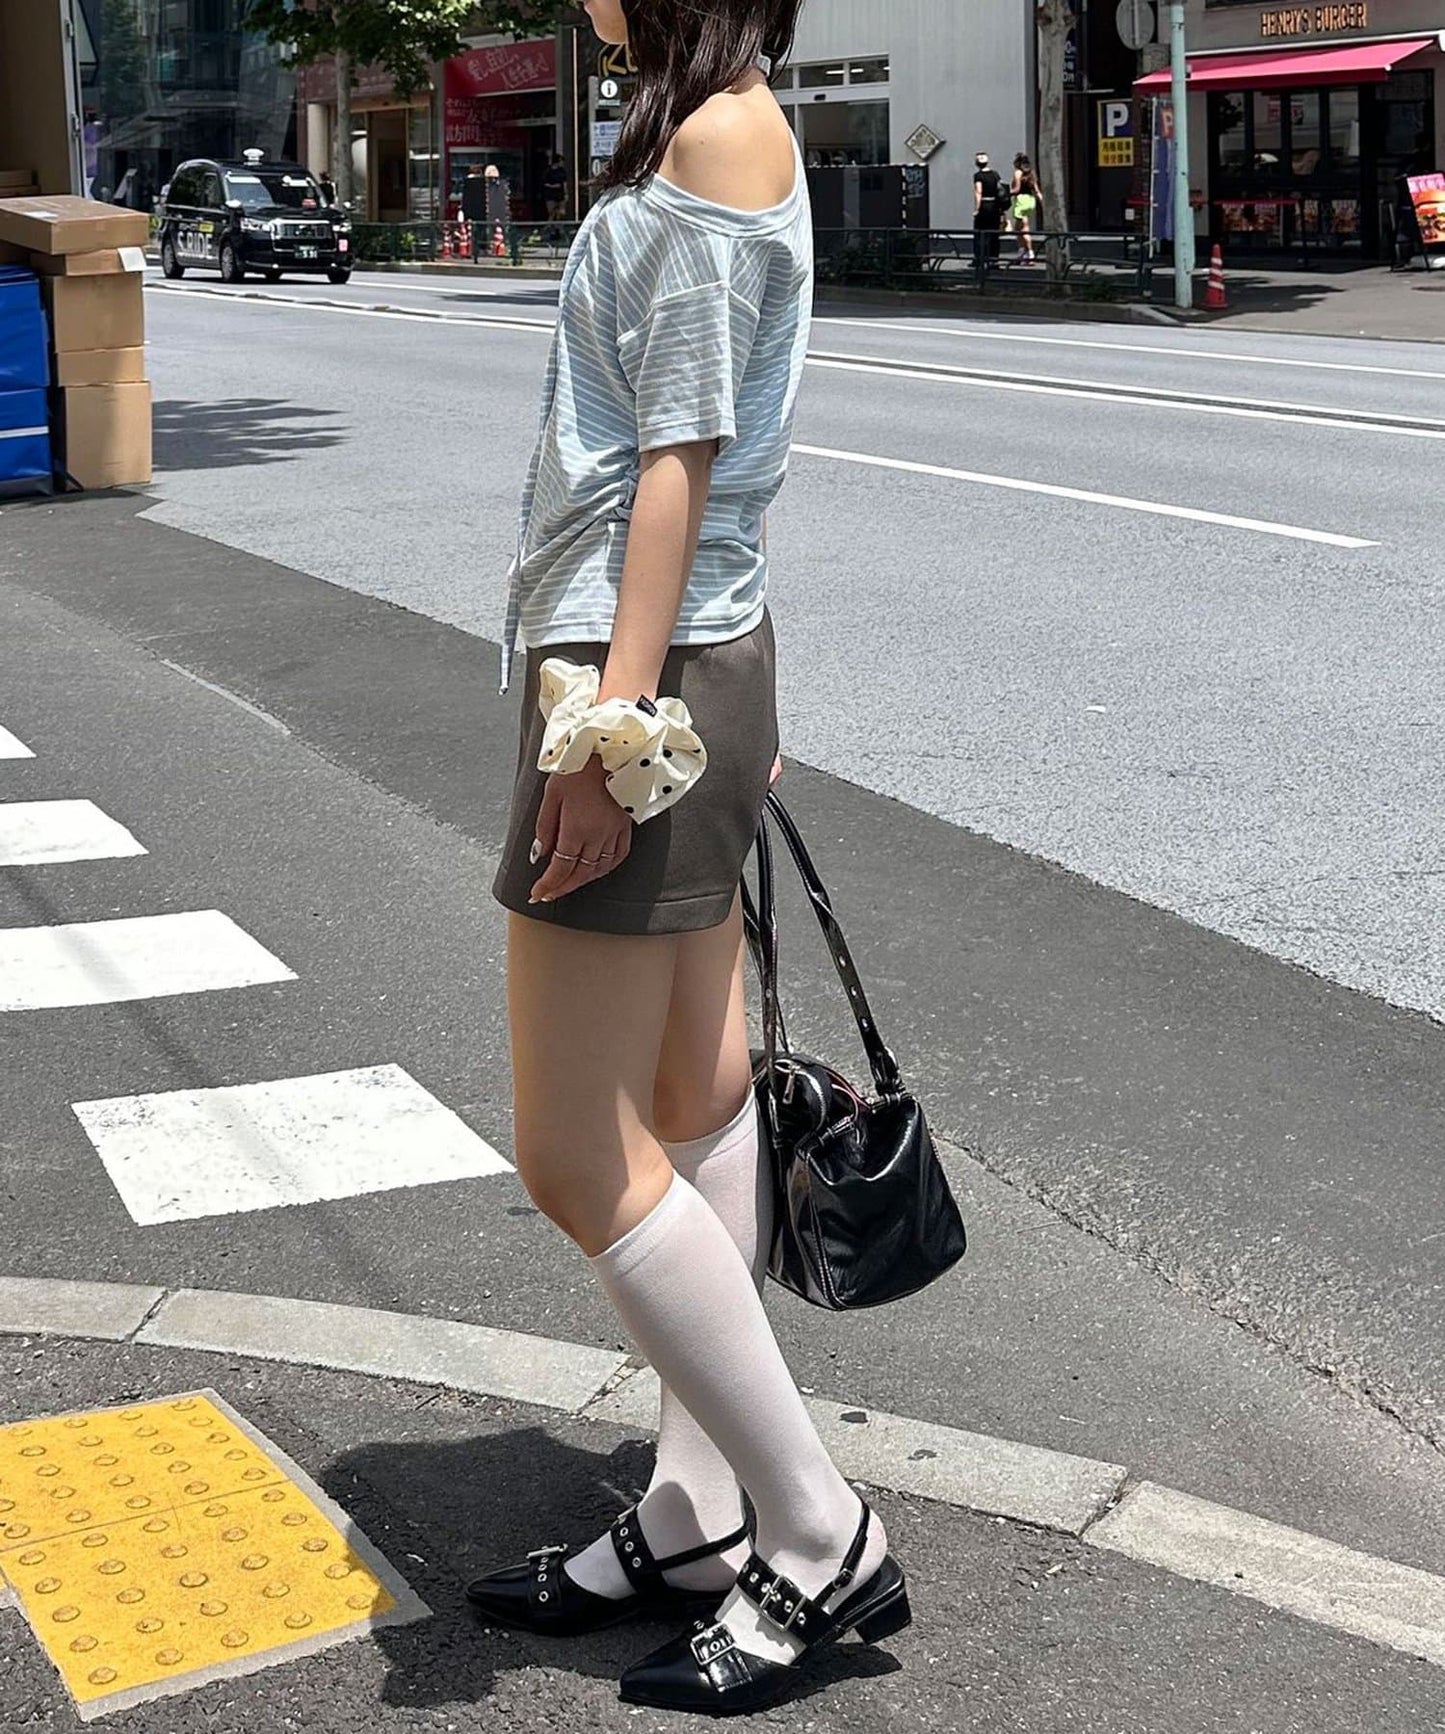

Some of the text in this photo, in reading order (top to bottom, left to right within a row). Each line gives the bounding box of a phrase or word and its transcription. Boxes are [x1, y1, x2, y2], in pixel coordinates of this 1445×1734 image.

[1261, 3, 1367, 37] HENRY'S BURGER
[1106, 103, 1129, 137] P
